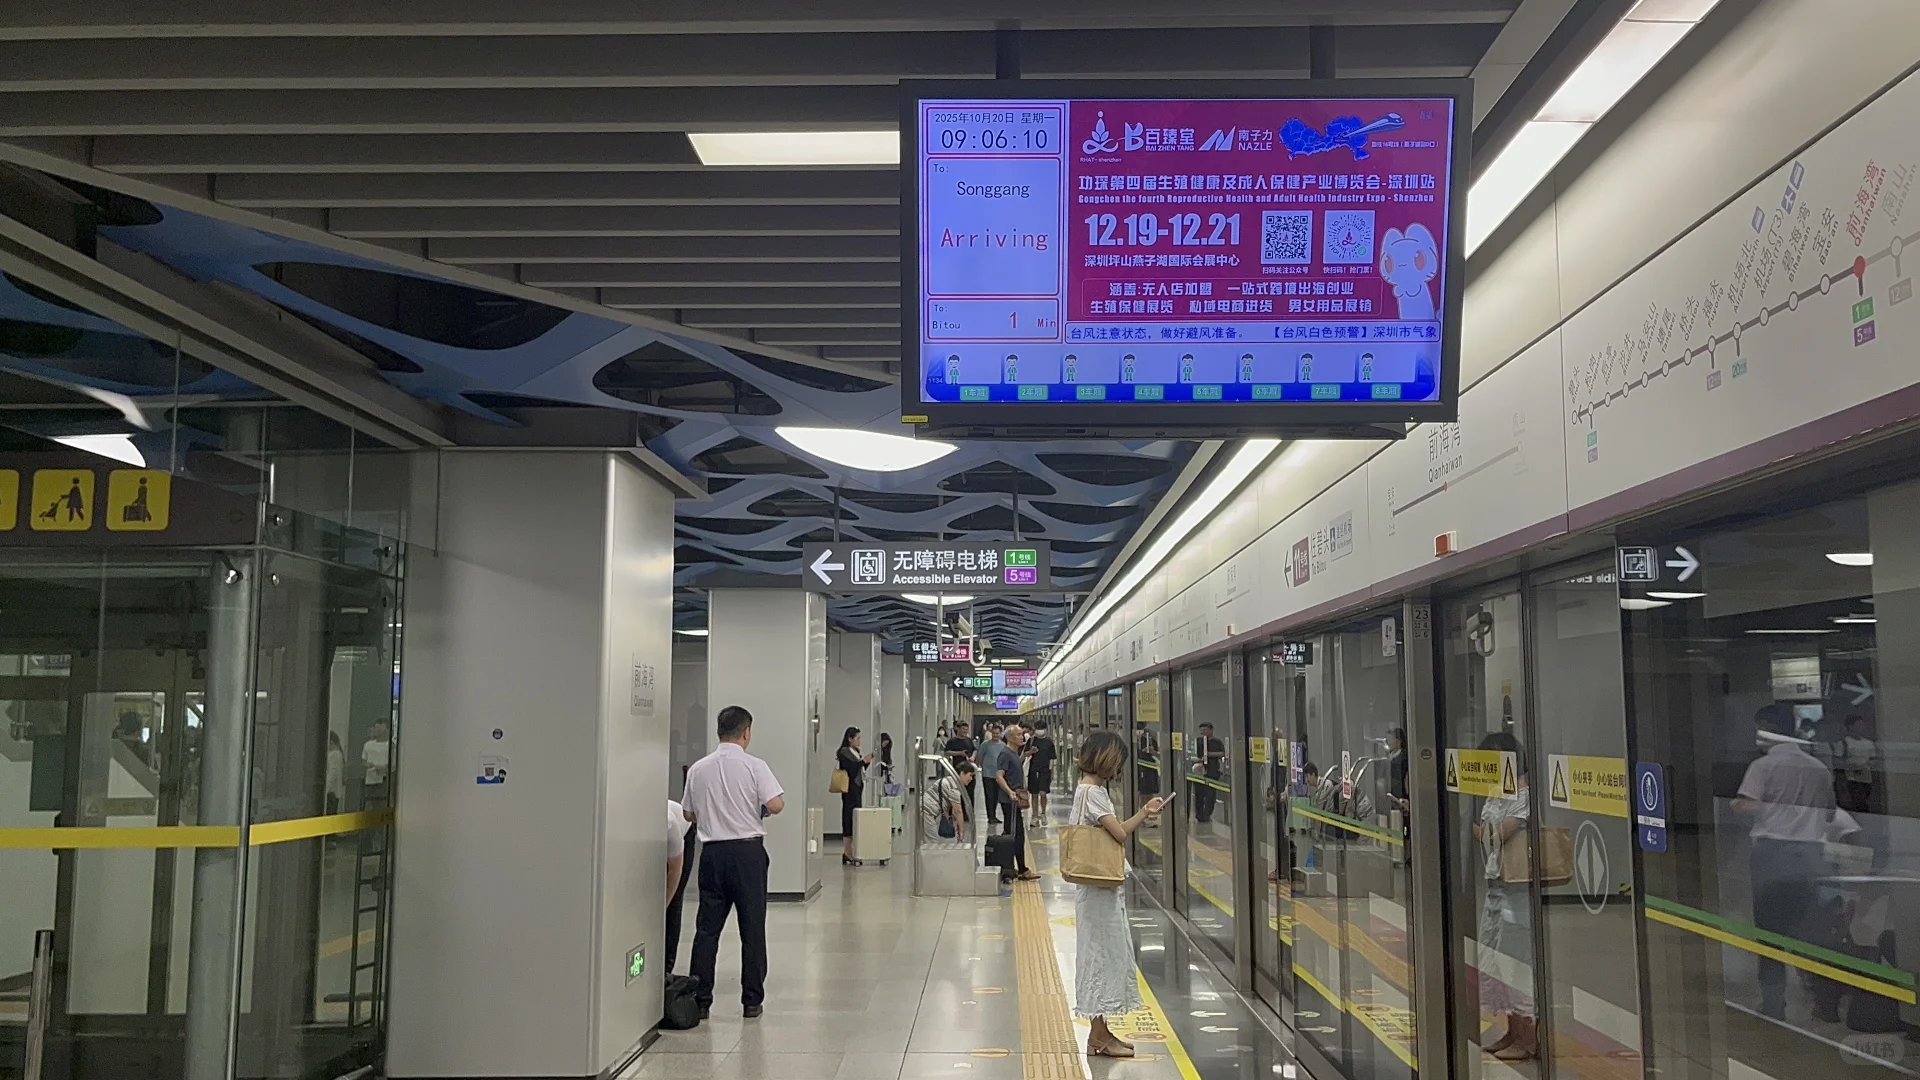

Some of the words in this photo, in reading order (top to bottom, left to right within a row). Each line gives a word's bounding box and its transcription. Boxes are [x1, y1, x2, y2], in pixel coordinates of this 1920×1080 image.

[934, 112, 1014, 124] 2025年10月20日
[1020, 112, 1055, 124] 星期一
[941, 129, 1048, 149] 09:06:10
[1145, 128, 1195, 145] 百臻堂
[1238, 129, 1273, 141] 南子力
[1238, 142, 1272, 151] NAZLE
[933, 163, 949, 173] To:
[956, 181, 1031, 199] Songgang
[1078, 194, 1121, 204] Gongchen
[1122, 194, 1137, 202] the
[1138, 194, 1165, 203] fourth
[1167, 194, 1224, 204] Reproductive
[1226, 194, 1253, 203] Health
[1255, 194, 1271, 203] and
[1273, 194, 1296, 202] Adult
[1298, 194, 1326, 202] Health
[1328, 194, 1364, 203] Industry
[1366, 194, 1385, 203] Expo
[1393, 194, 1434, 202] Shenzhen
[1846, 158, 1880, 240] 前海湾
[1084, 213, 1240, 246] 12.19-12.21
[940, 227, 1049, 251] Arriving
[1084, 254, 1240, 267] 深圳坪山燕子湖国际会展中心
[1262, 266, 1309, 274] 扫码关注公众号
[1227, 281, 1354, 296] 一站式跨境出海创业
[934, 304, 948, 312] To:
[1090, 300, 1173, 314] 生殖保健展览
[1189, 299, 1273, 313] 私域电商进货
[1288, 299, 1372, 313] 男女用品展销
[932, 320, 961, 330] Bitou
[1009, 311, 1018, 329] 1
[1037, 318, 1057, 328] Min
[1067, 327, 1244, 340] 台风注意状态，做好避风准备。
[1428, 454, 1463, 483] Qianhaiwan
[1311, 526, 1330, 560] 往碧头
[892, 549, 999, 572] 无障碍电梯
[892, 574, 951, 585] Accessible
[953, 574, 998, 585] Elevator
[1415, 609, 1429, 620] 23
